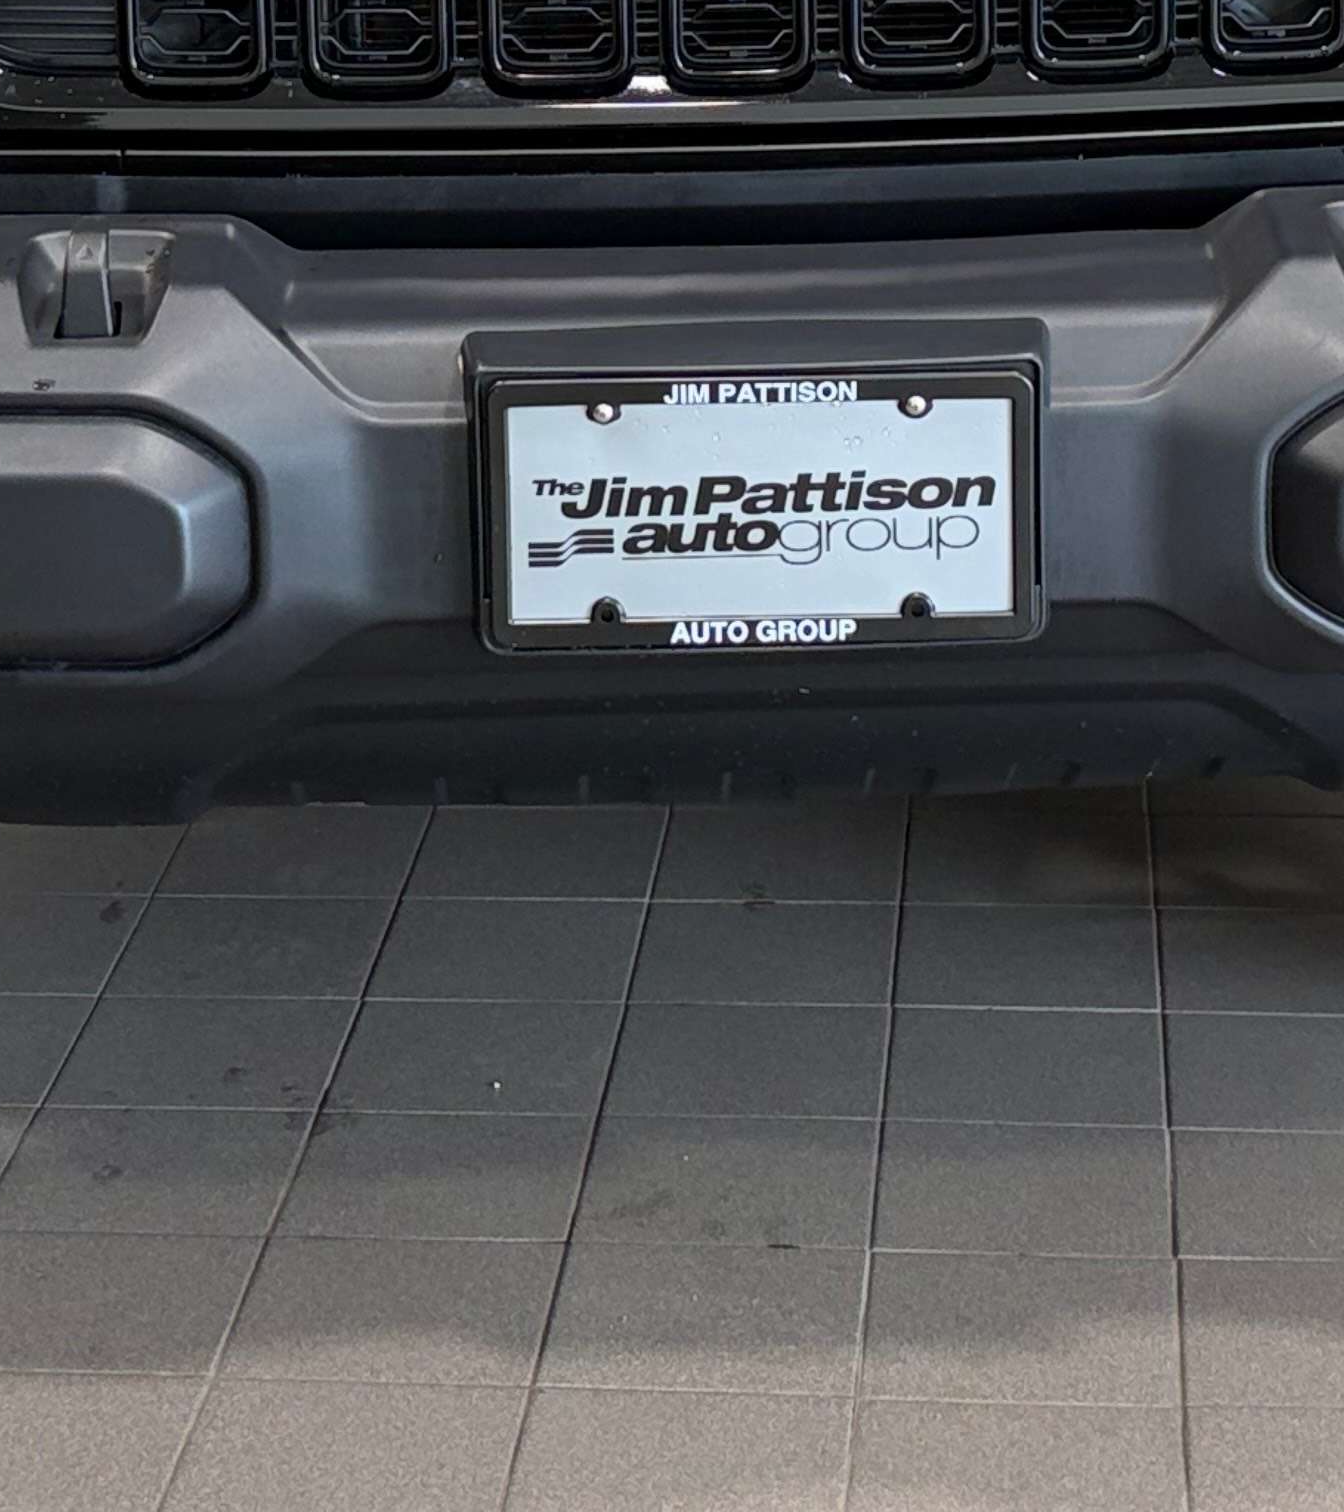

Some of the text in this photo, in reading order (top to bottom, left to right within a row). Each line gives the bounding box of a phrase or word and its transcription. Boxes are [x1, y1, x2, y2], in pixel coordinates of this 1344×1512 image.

[663, 380, 858, 405] JIM PATTISON
[532, 470, 996, 520] The Jim Pattison
[670, 618, 858, 644] AUTO GROUP
